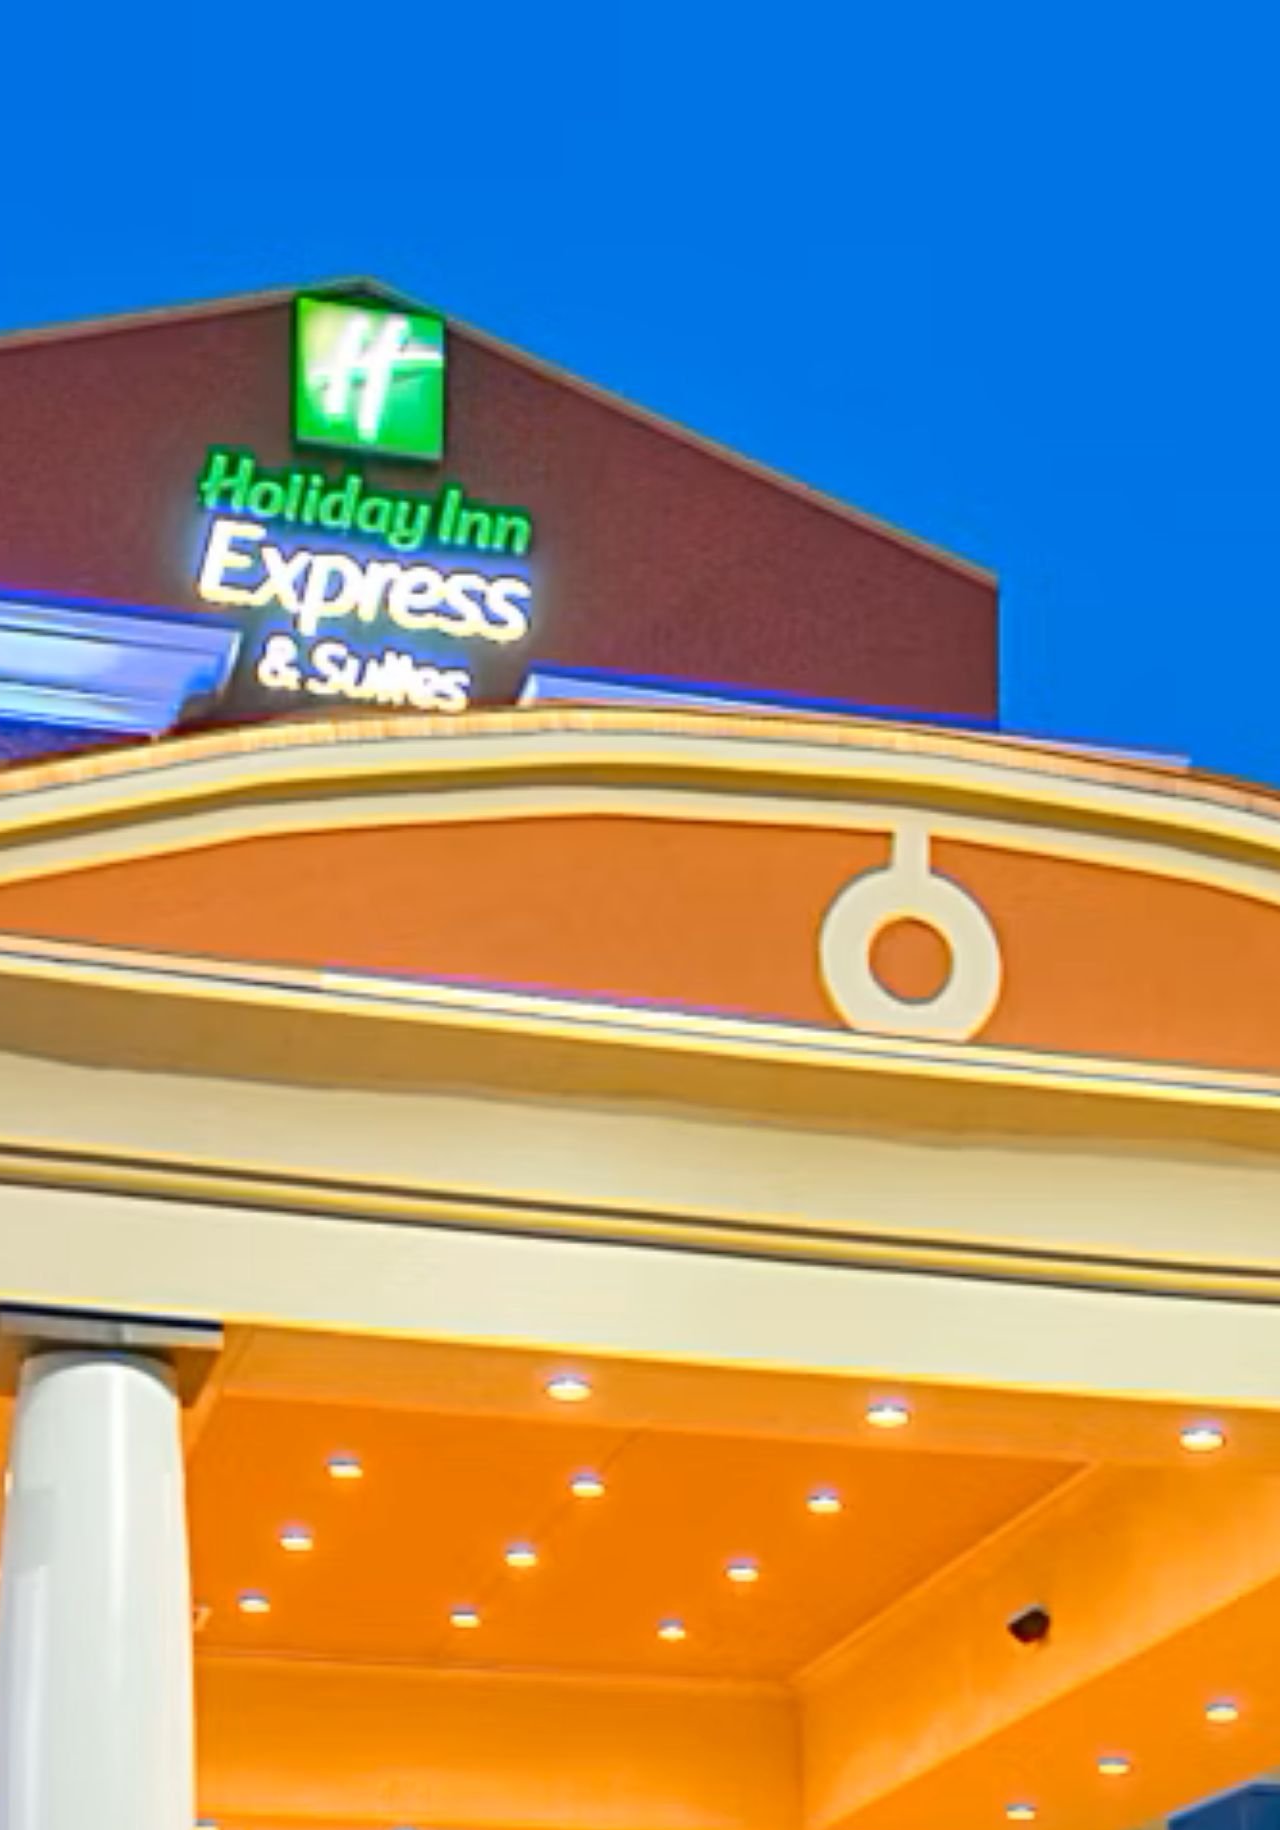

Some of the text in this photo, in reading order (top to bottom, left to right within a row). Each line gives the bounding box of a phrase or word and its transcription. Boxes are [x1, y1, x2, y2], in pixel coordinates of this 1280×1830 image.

[200, 450, 533, 555] Holiday Inn
[198, 518, 532, 642] Express
[257, 634, 471, 713] & Suites
